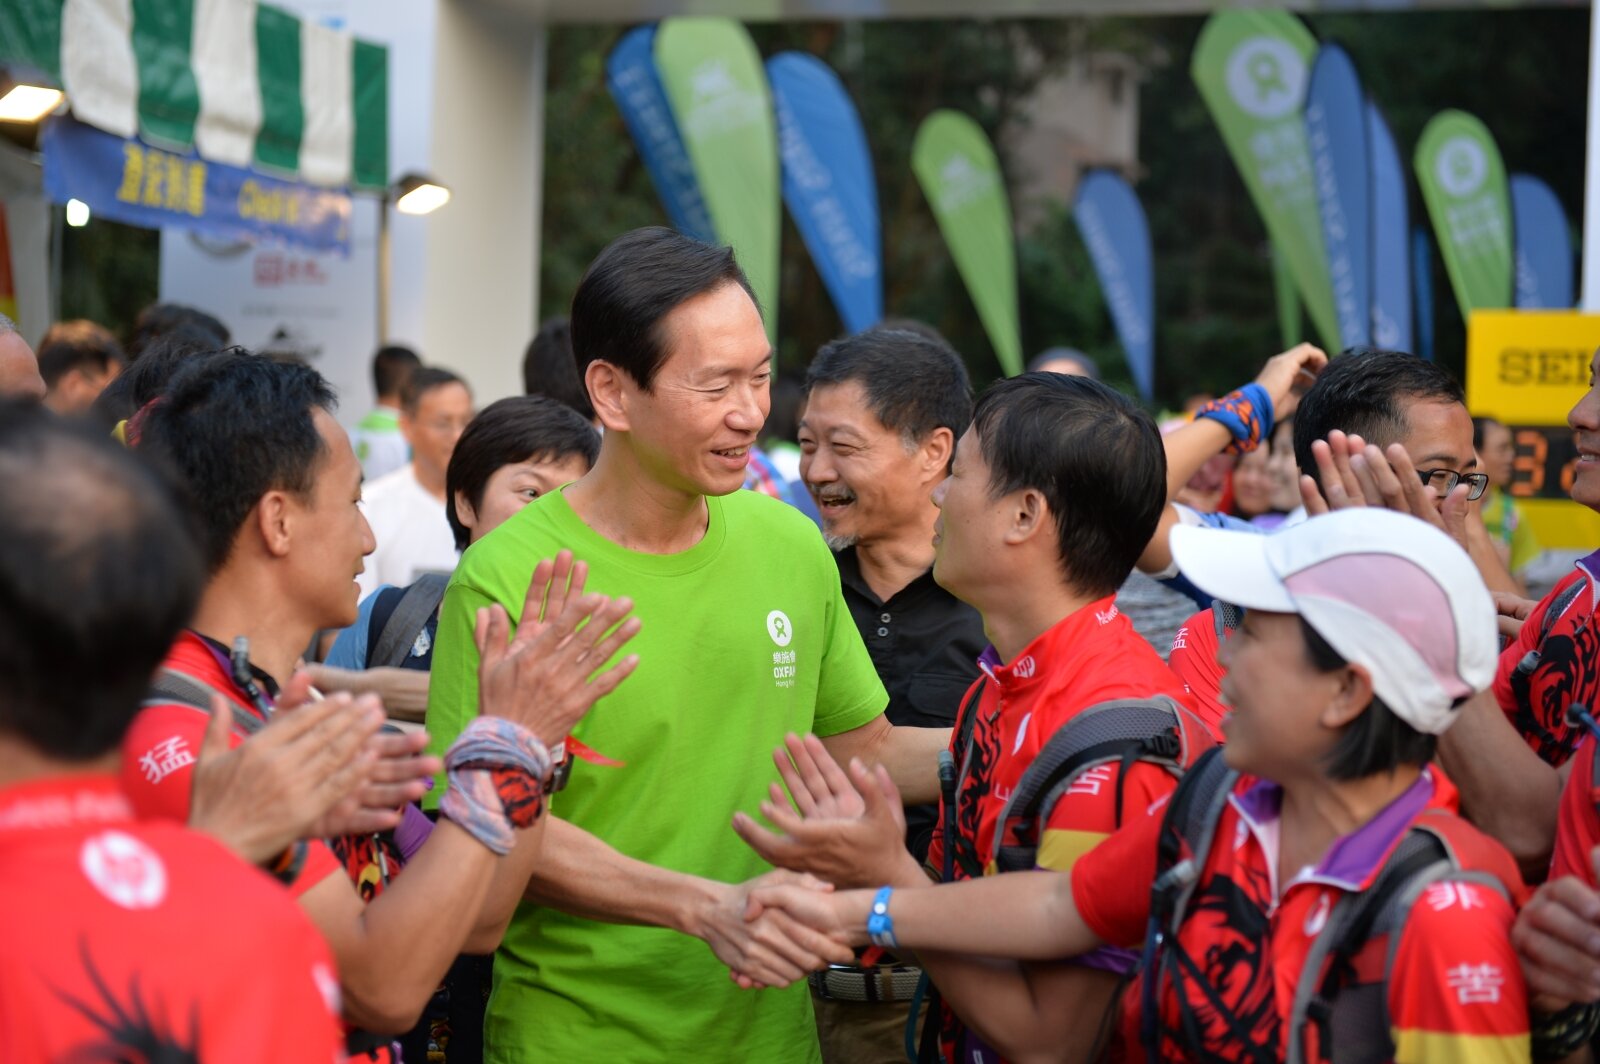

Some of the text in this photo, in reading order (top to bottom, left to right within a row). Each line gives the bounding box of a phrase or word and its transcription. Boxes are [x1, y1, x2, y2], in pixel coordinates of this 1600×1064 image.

[1499, 350, 1592, 386] SEI
[139, 736, 196, 784] 猛
[1447, 963, 1504, 1004] 苦
